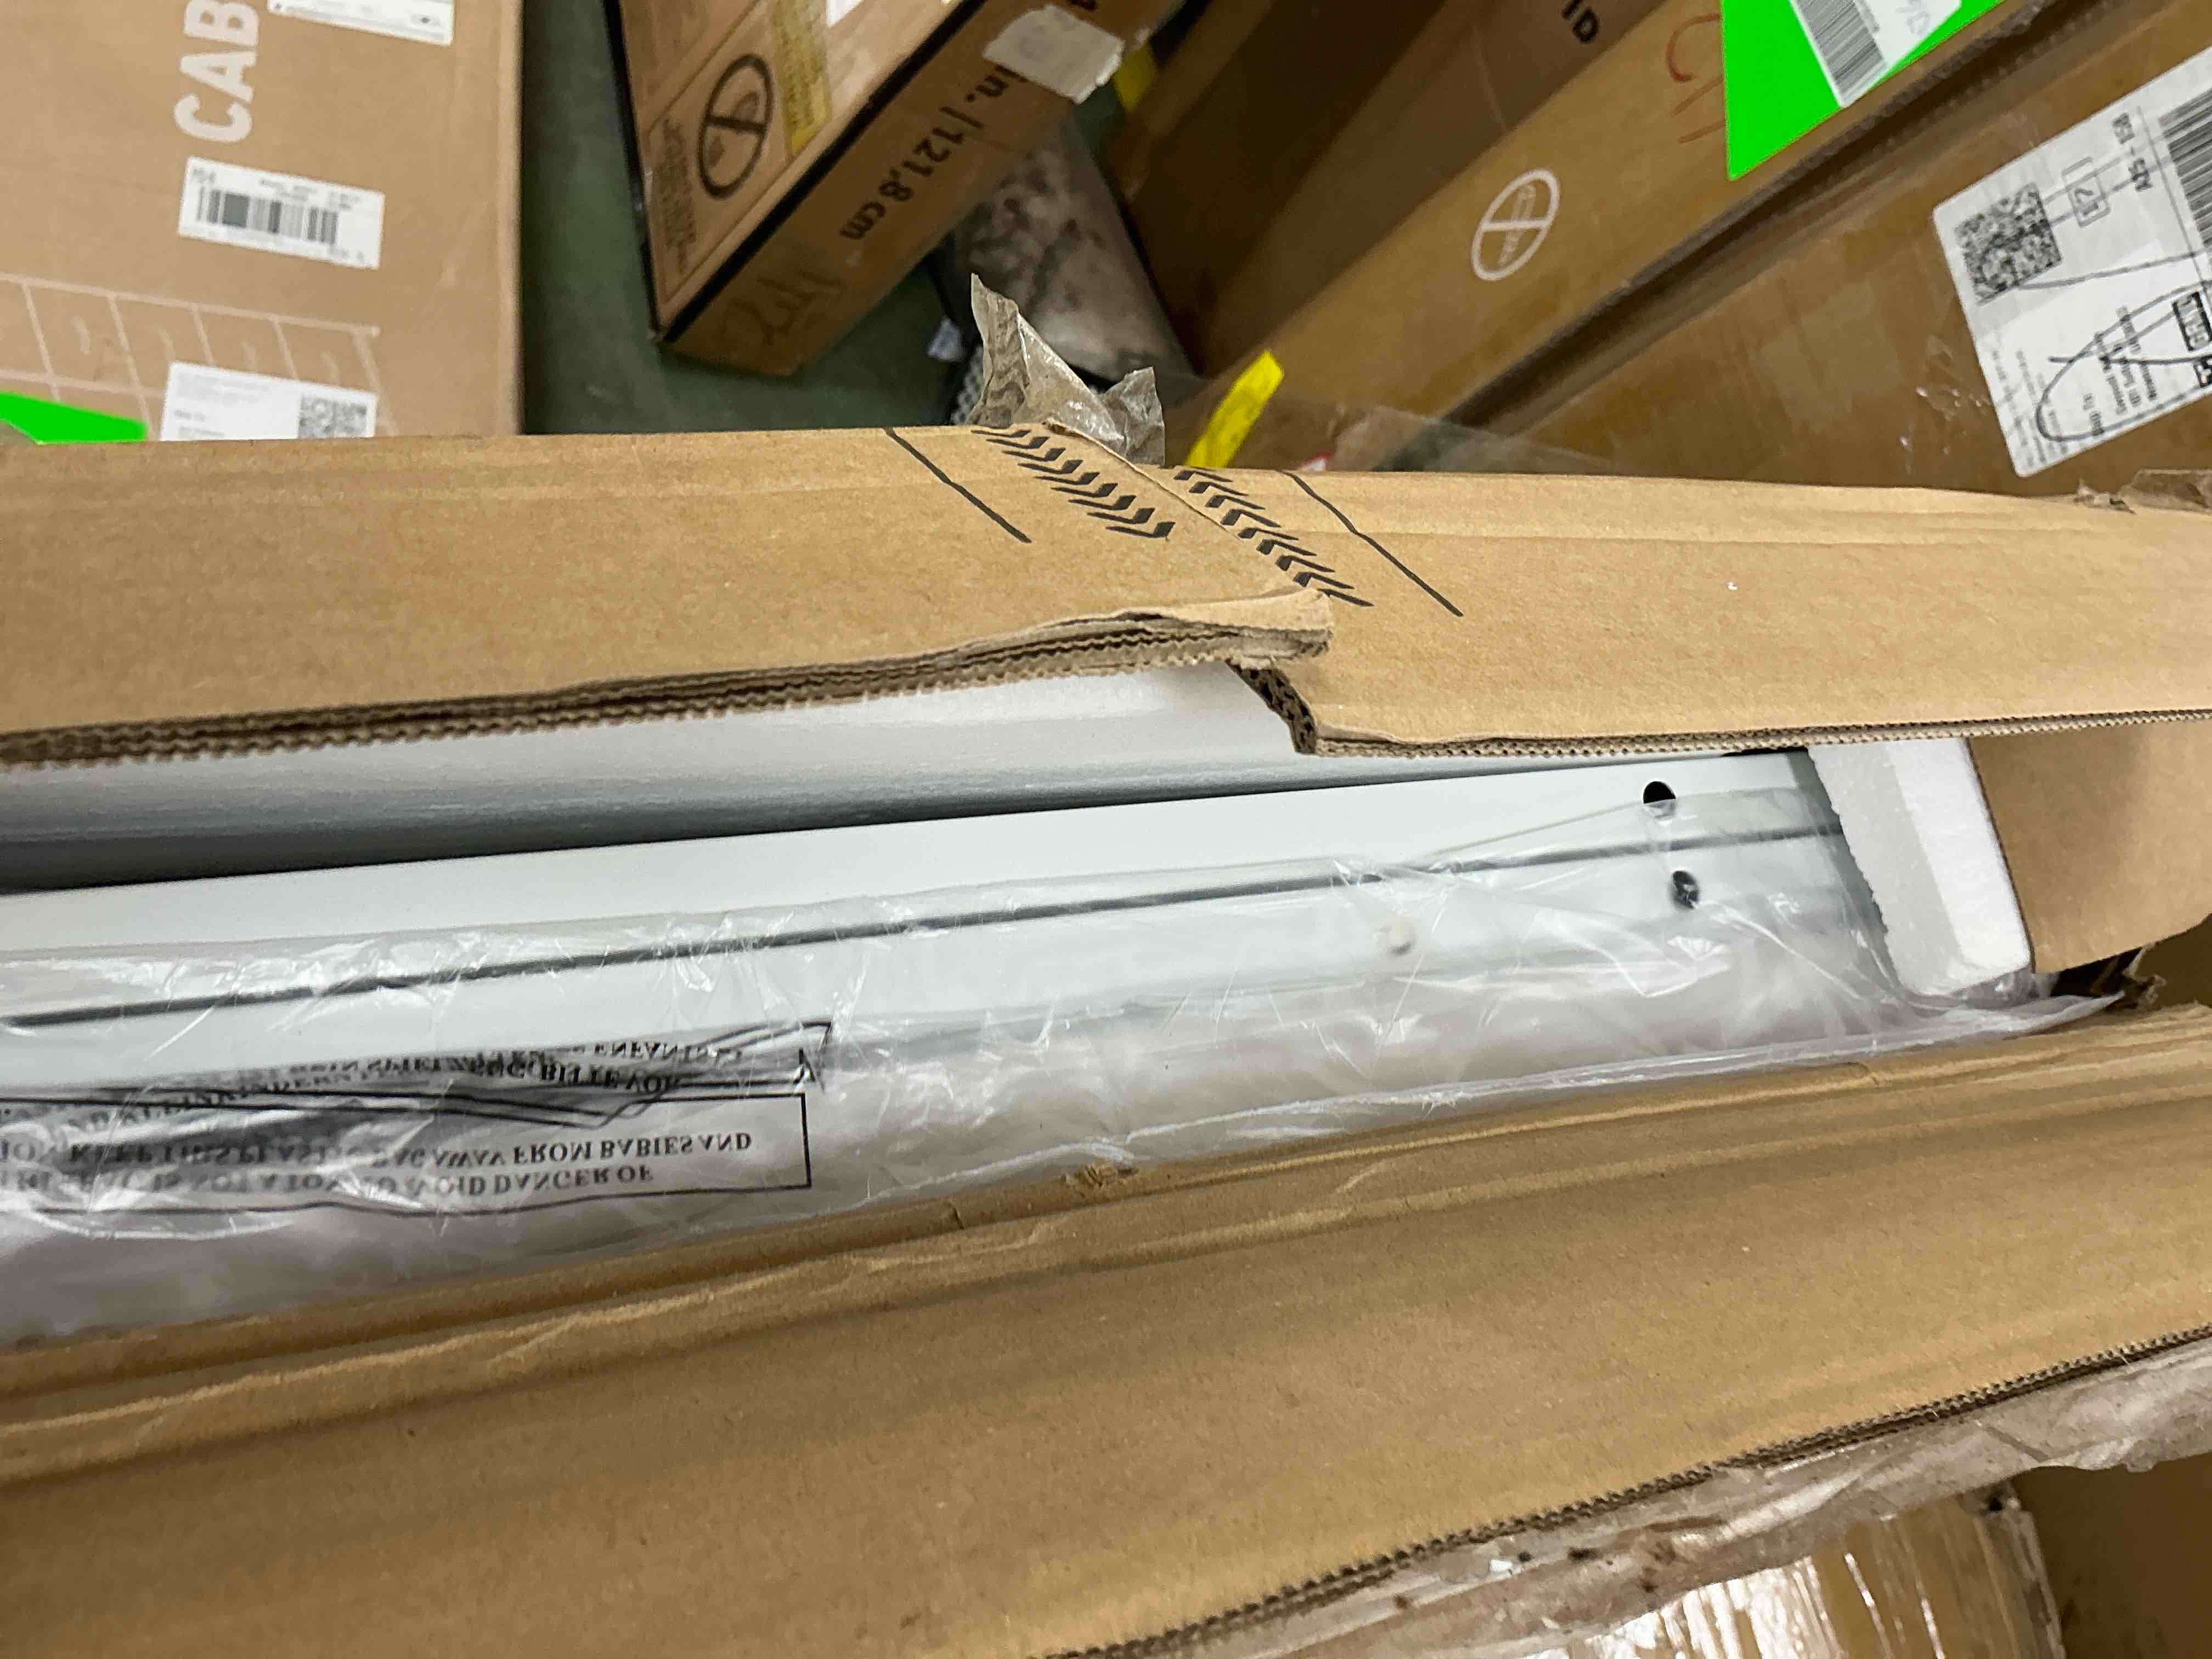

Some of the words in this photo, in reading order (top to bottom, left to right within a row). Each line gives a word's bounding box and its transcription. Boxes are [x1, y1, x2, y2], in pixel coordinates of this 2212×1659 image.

[174, 0, 259, 144] CAB
[879, 127, 964, 202] 121,8
[839, 201, 886, 240] cm
